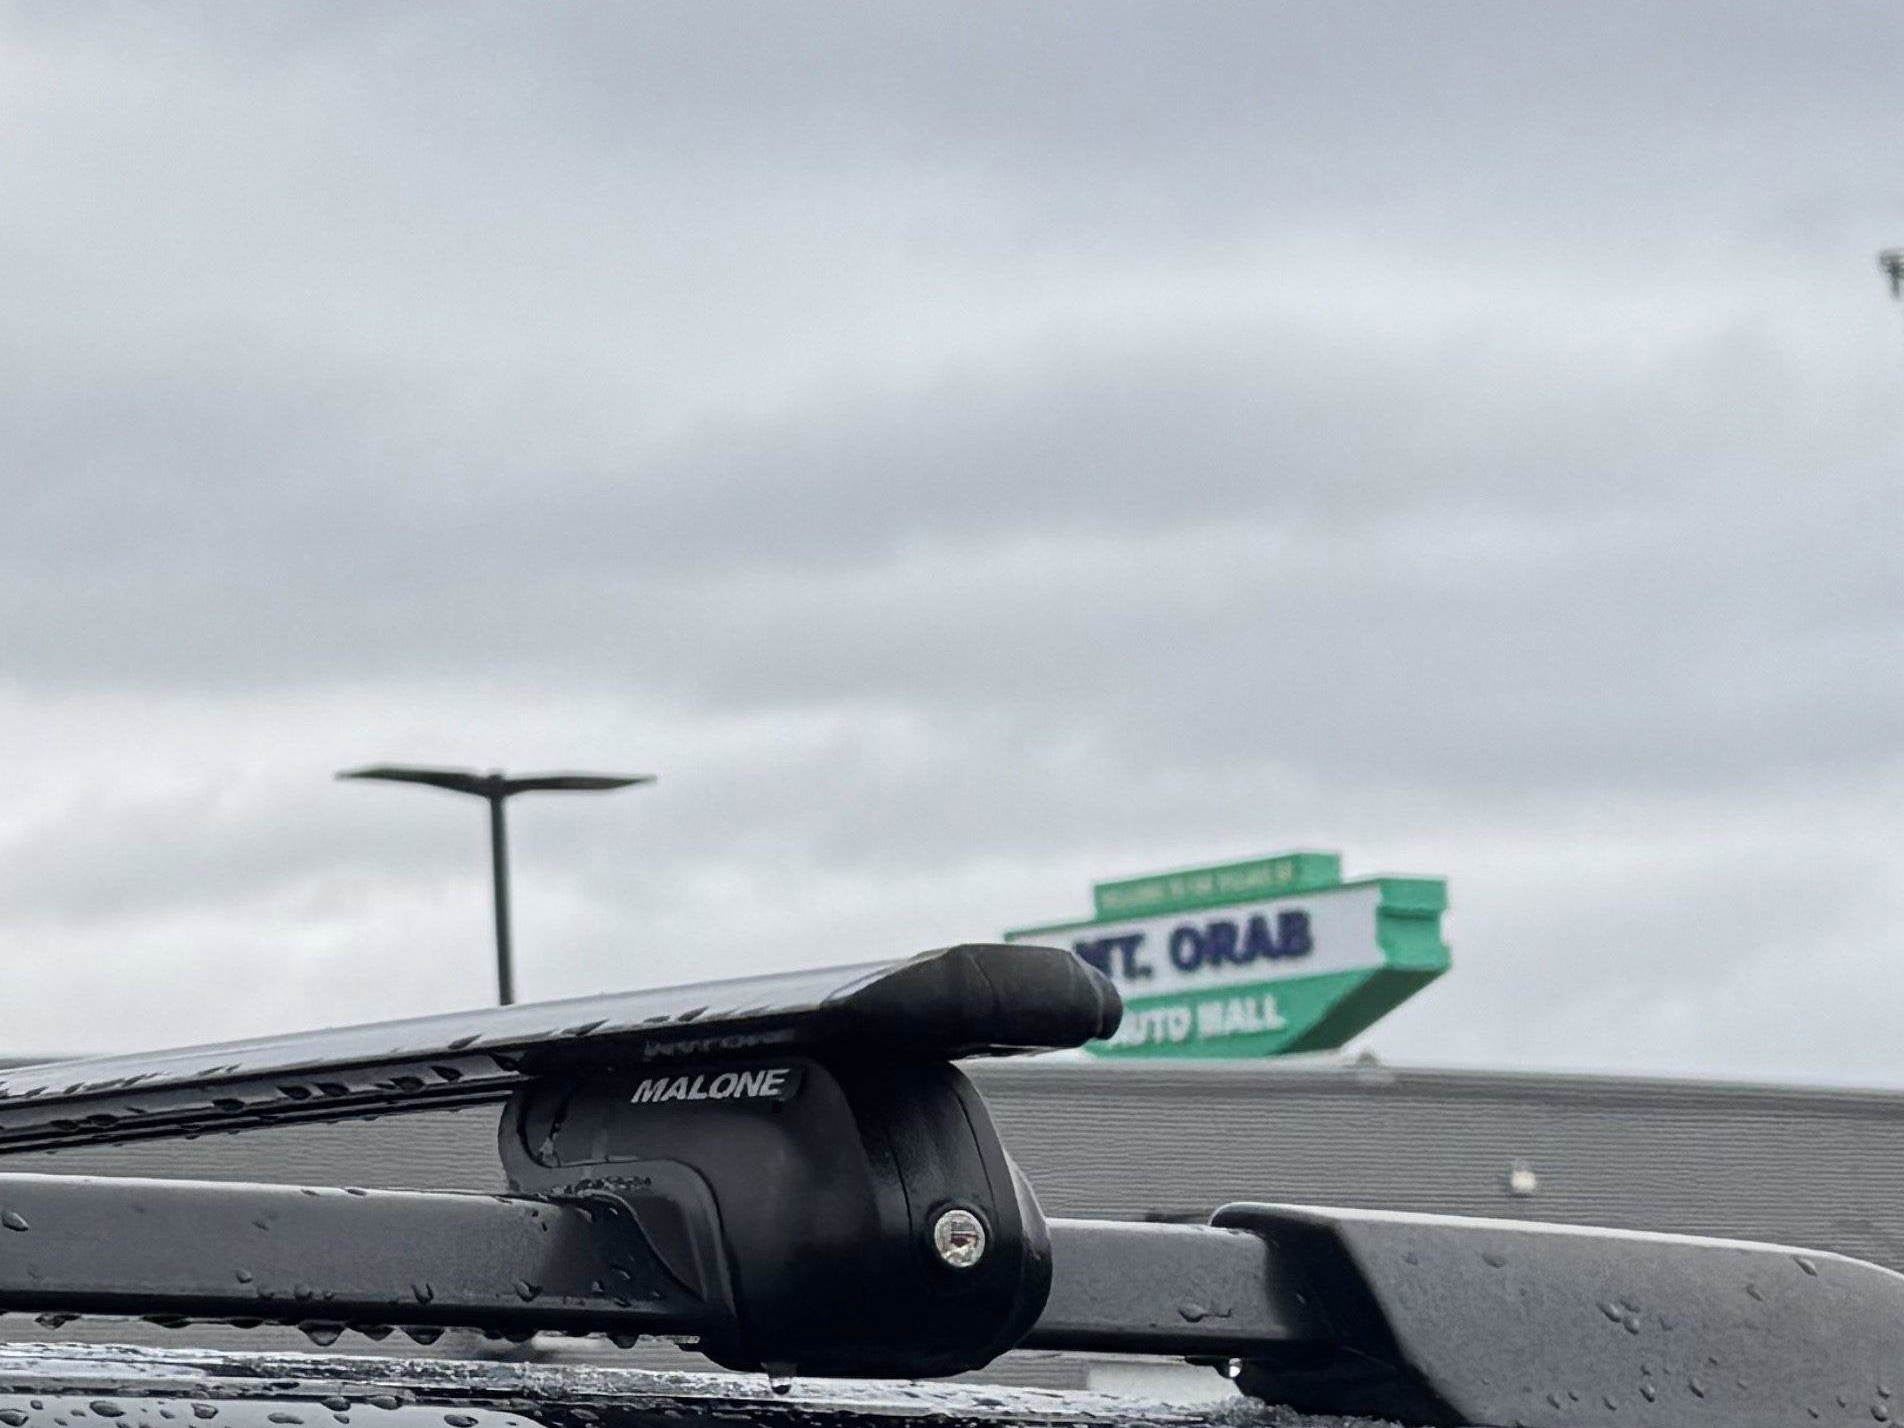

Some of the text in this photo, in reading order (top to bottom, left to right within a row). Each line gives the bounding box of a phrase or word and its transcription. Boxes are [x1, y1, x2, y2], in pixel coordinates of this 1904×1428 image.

[1168, 909, 1312, 972] ORAB
[1196, 992, 1287, 1040] MALL
[630, 1068, 791, 1104] MALONE
